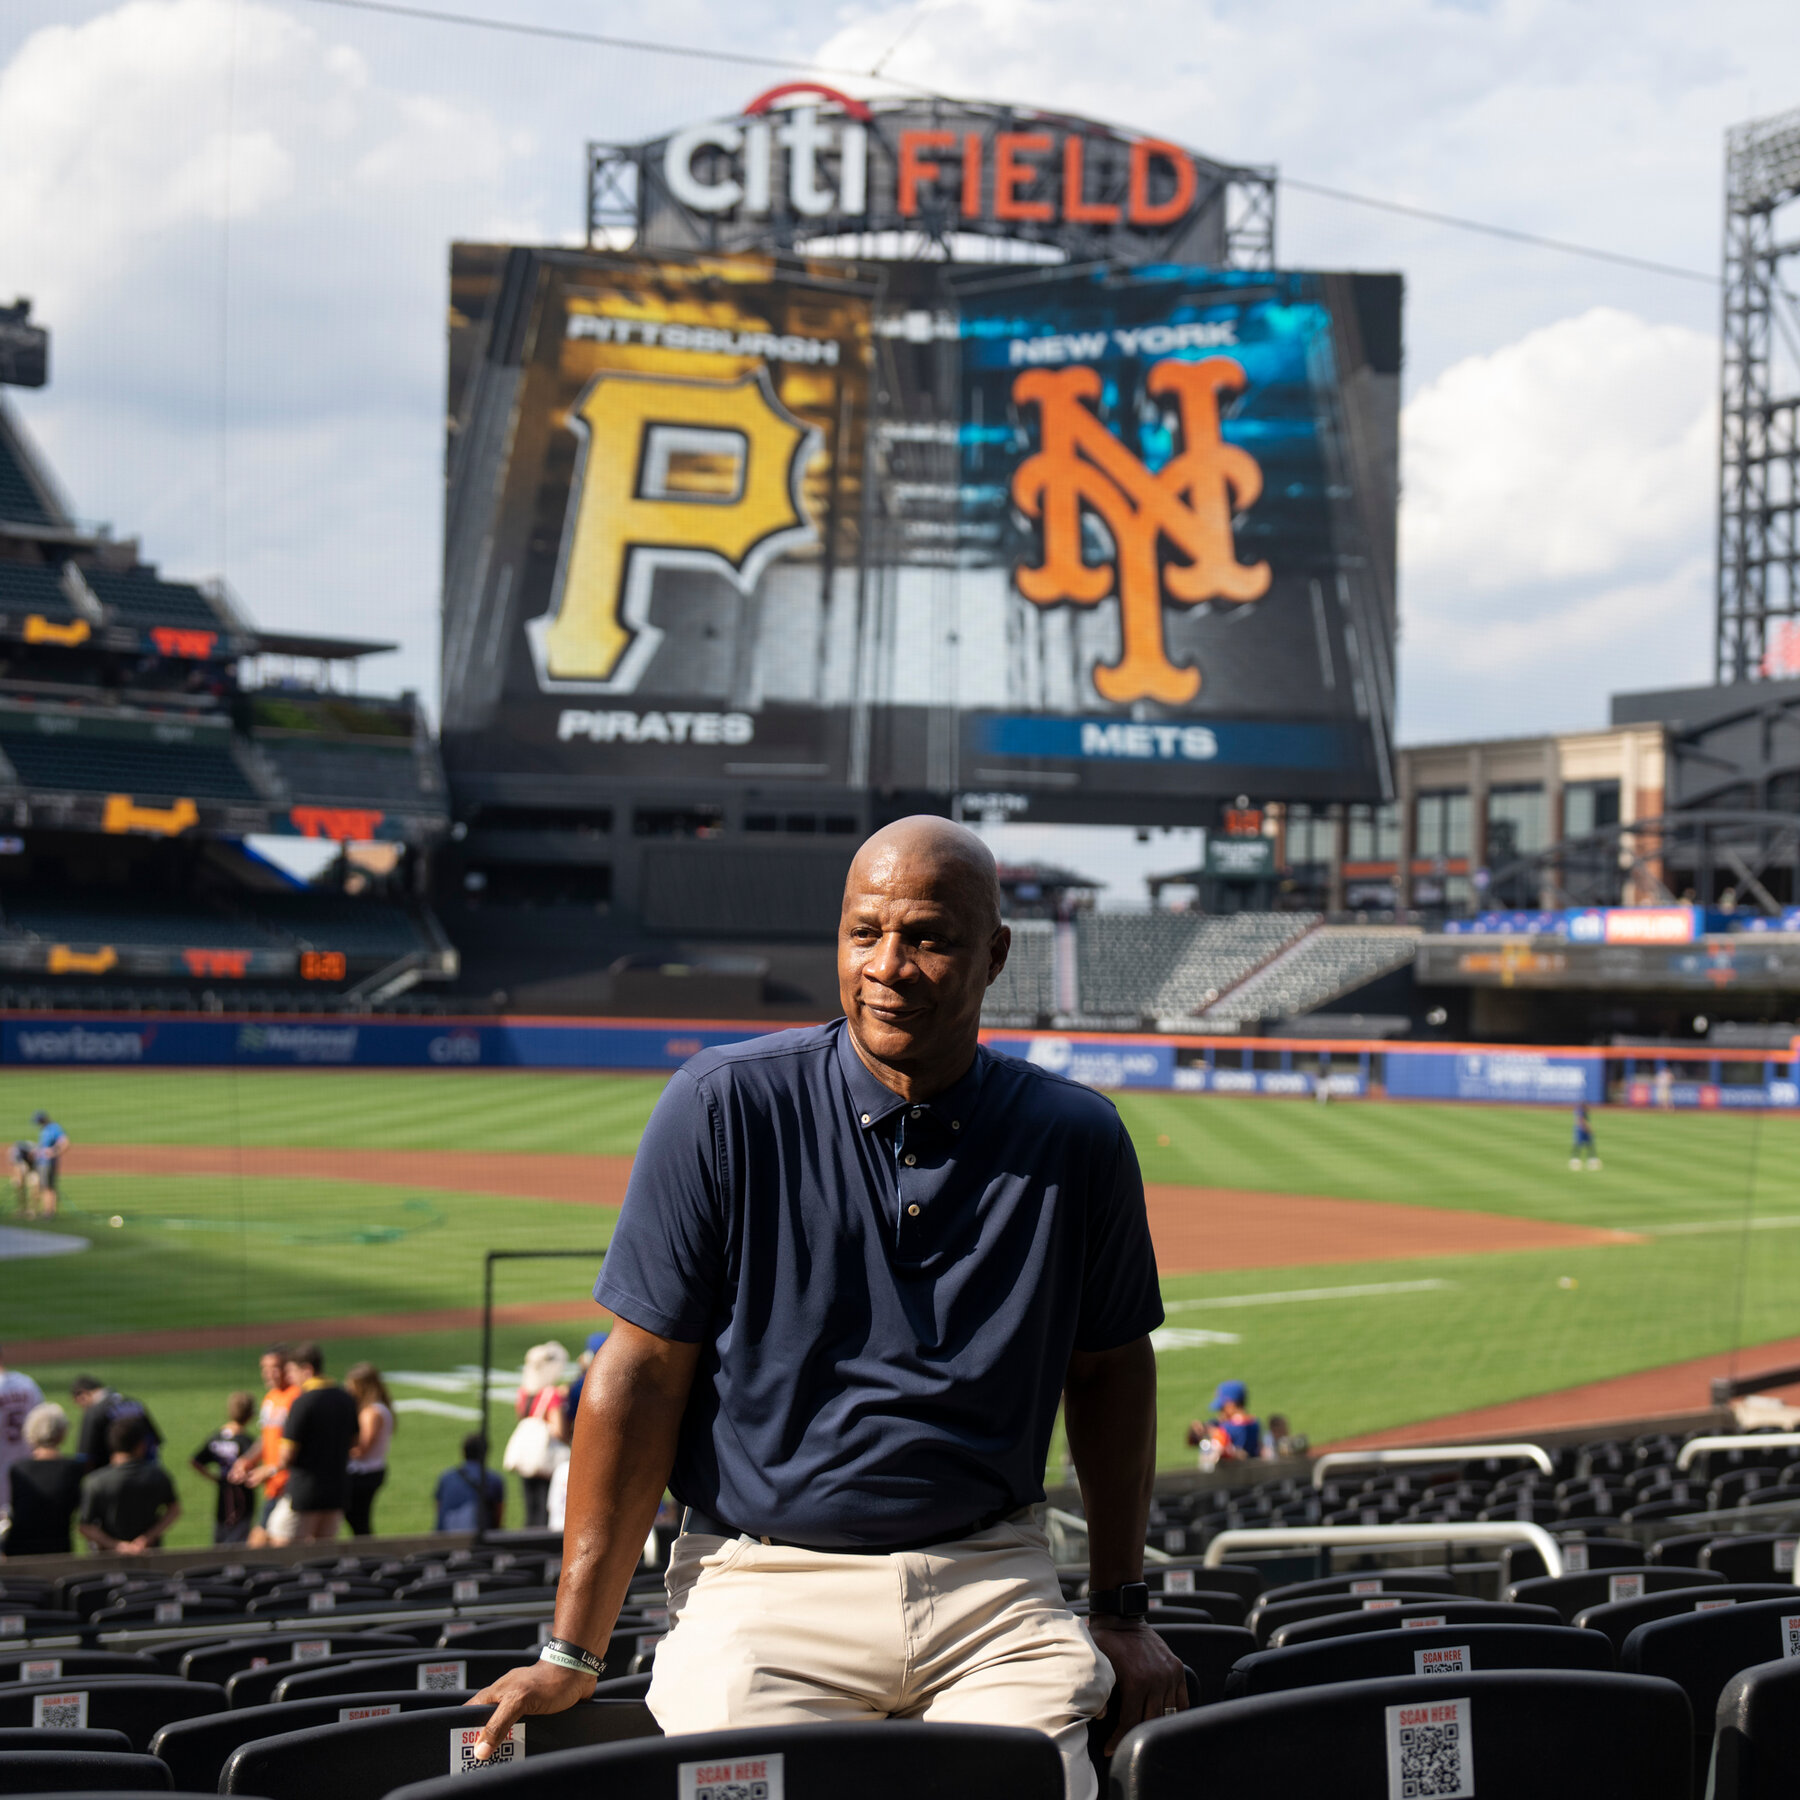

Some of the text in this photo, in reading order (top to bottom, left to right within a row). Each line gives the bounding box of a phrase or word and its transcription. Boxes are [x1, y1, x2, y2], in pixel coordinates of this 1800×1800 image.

[664, 102, 1197, 226] citi FIELD
[566, 312, 840, 367] PITTSBURGH
[1009, 320, 1240, 367] NEW YORK
[557, 709, 754, 745] PIRATES
[1081, 723, 1218, 761] METS
[550, 1653, 582, 1667] RESTORED
[581, 1651, 599, 1670] Luke
[1423, 1649, 1462, 1664] SCAN HERE
[348, 1709, 370, 1720] SCAN
[1399, 1704, 1457, 1726] SCAN HERE
[462, 1730, 481, 1744] SCA
[696, 1760, 767, 1785] SCAN HERE
